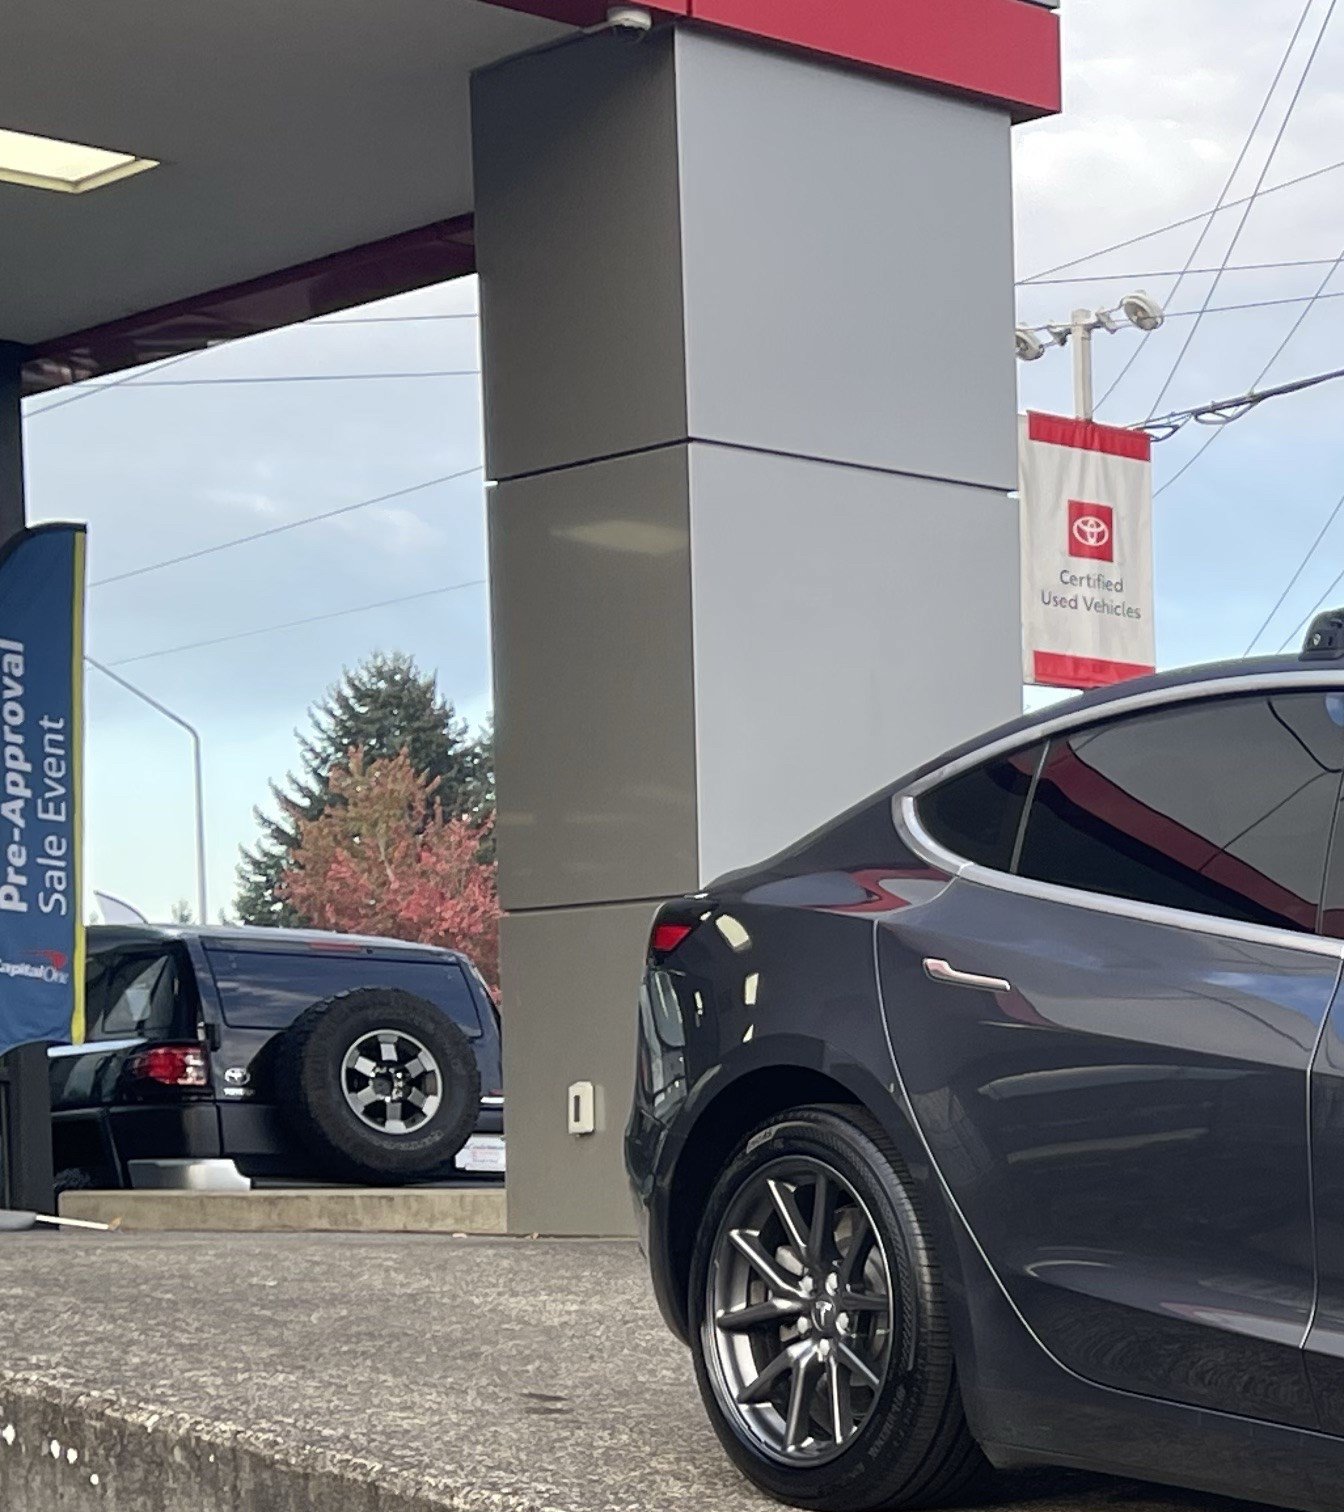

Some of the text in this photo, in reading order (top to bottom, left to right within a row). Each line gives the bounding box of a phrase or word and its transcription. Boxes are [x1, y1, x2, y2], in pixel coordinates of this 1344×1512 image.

[1060, 569, 1124, 593] Certified
[1041, 589, 1142, 620] Used Vehicles
[0, 639, 32, 912] Pre-Approval
[36, 714, 67, 916] Sale Event
[0, 958, 69, 985] apitalOne
